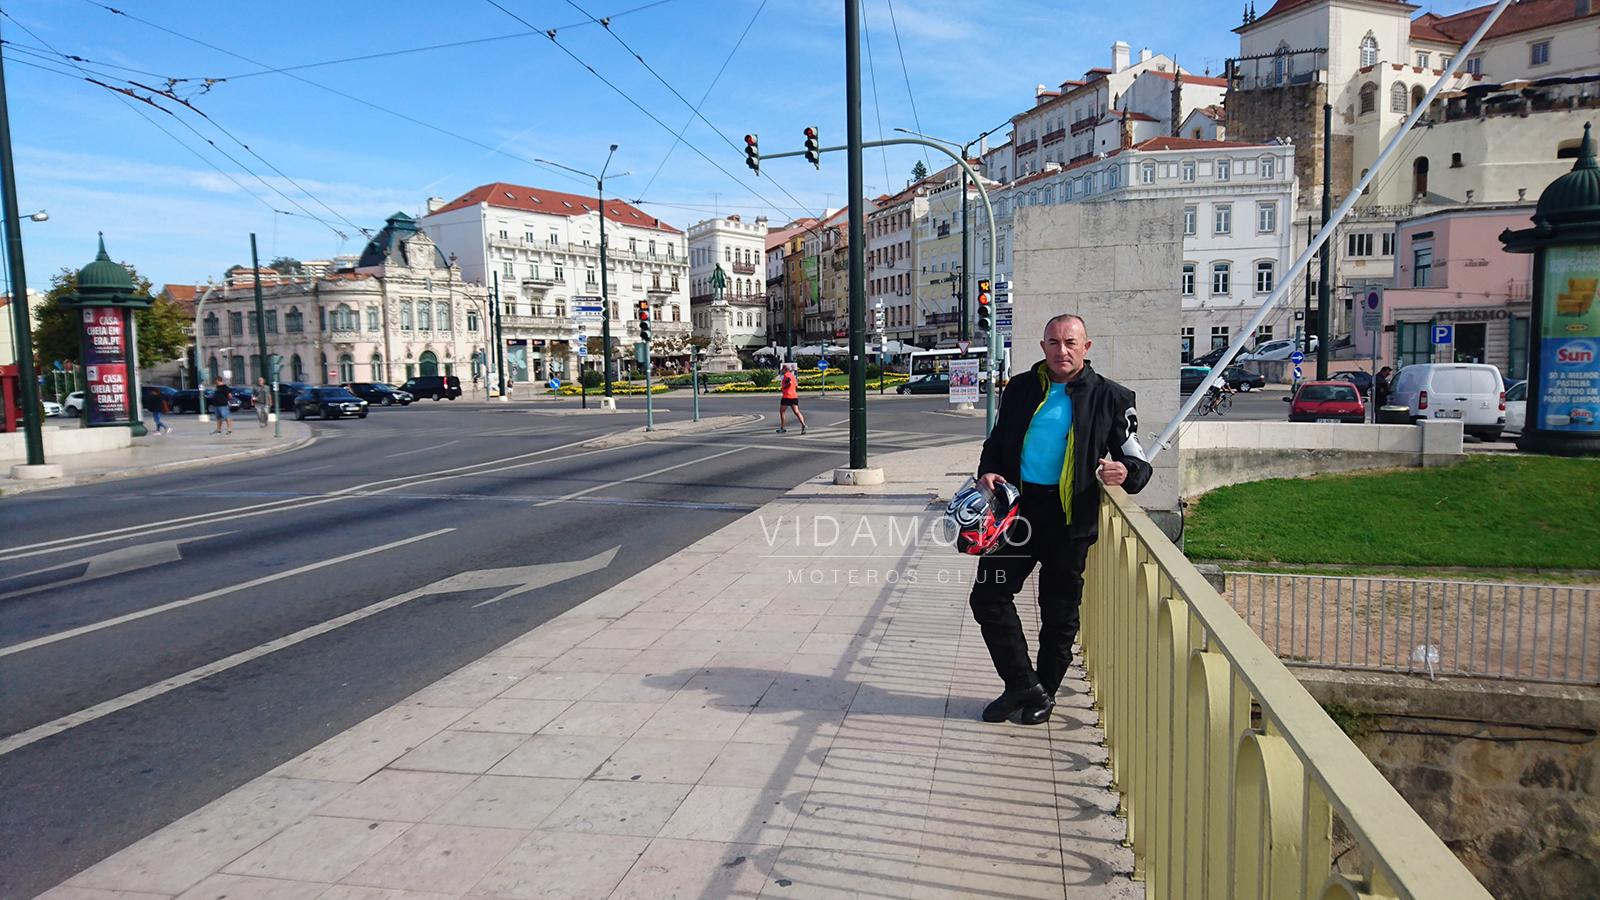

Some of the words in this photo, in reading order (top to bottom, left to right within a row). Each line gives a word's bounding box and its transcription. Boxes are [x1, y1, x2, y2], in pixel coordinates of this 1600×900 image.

[99, 316, 119, 325] CASA
[1438, 310, 1507, 321] TURISMO
[87, 326, 107, 336] CHEIA
[108, 326, 120, 336] EM
[1435, 327, 1449, 343] P
[93, 336, 121, 346] ERA.PT
[1558, 348, 1593, 362] Sun
[102, 374, 122, 384] CASA
[1568, 371, 1600, 379] MELHOR
[90, 384, 111, 394] CHEIA
[112, 384, 124, 394] EM
[97, 394, 125, 404] ERA.PT
[1544, 395, 1570, 403] PRATOS
